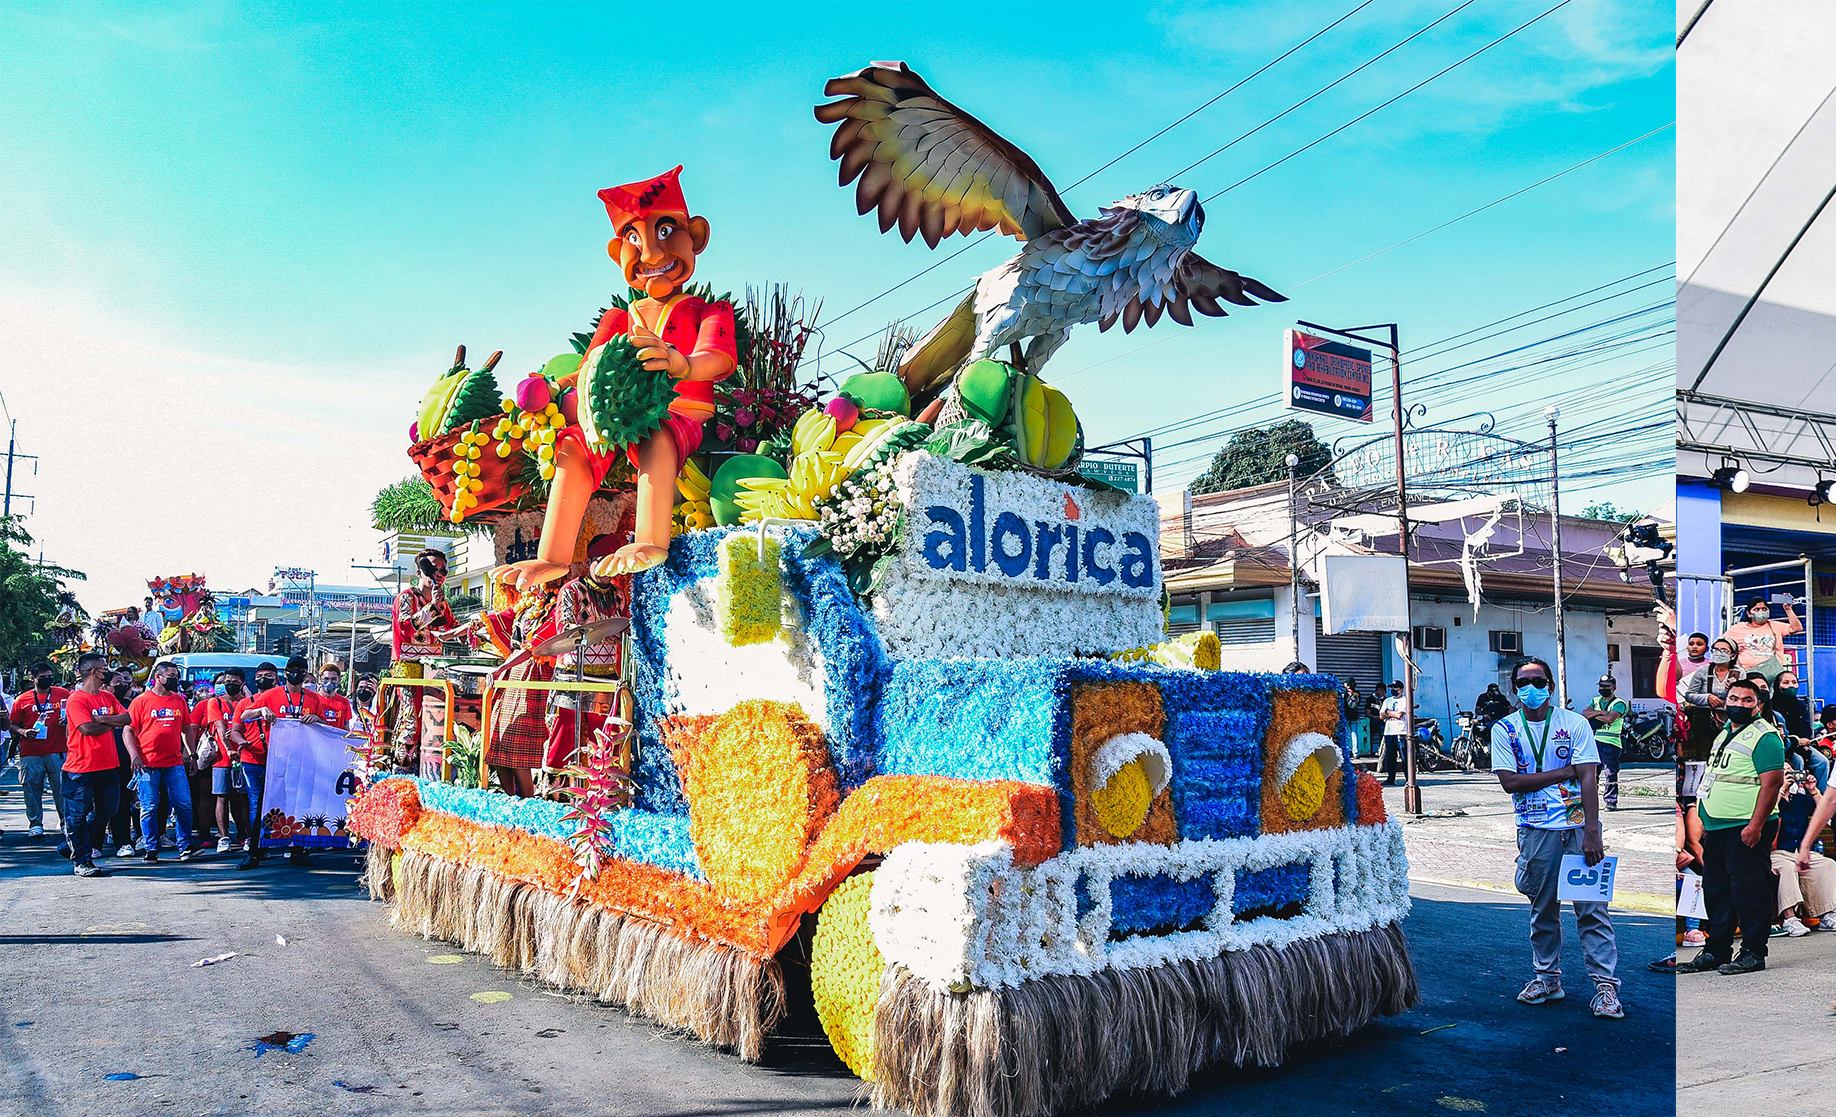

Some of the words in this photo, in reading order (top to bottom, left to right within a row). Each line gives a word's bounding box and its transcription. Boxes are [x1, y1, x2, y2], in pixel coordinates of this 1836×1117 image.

[1103, 463, 1135, 472] DUTERTE
[921, 474, 1153, 589] alorica
[32, 702, 61, 712] AORICA
[1567, 868, 1599, 886] 3
